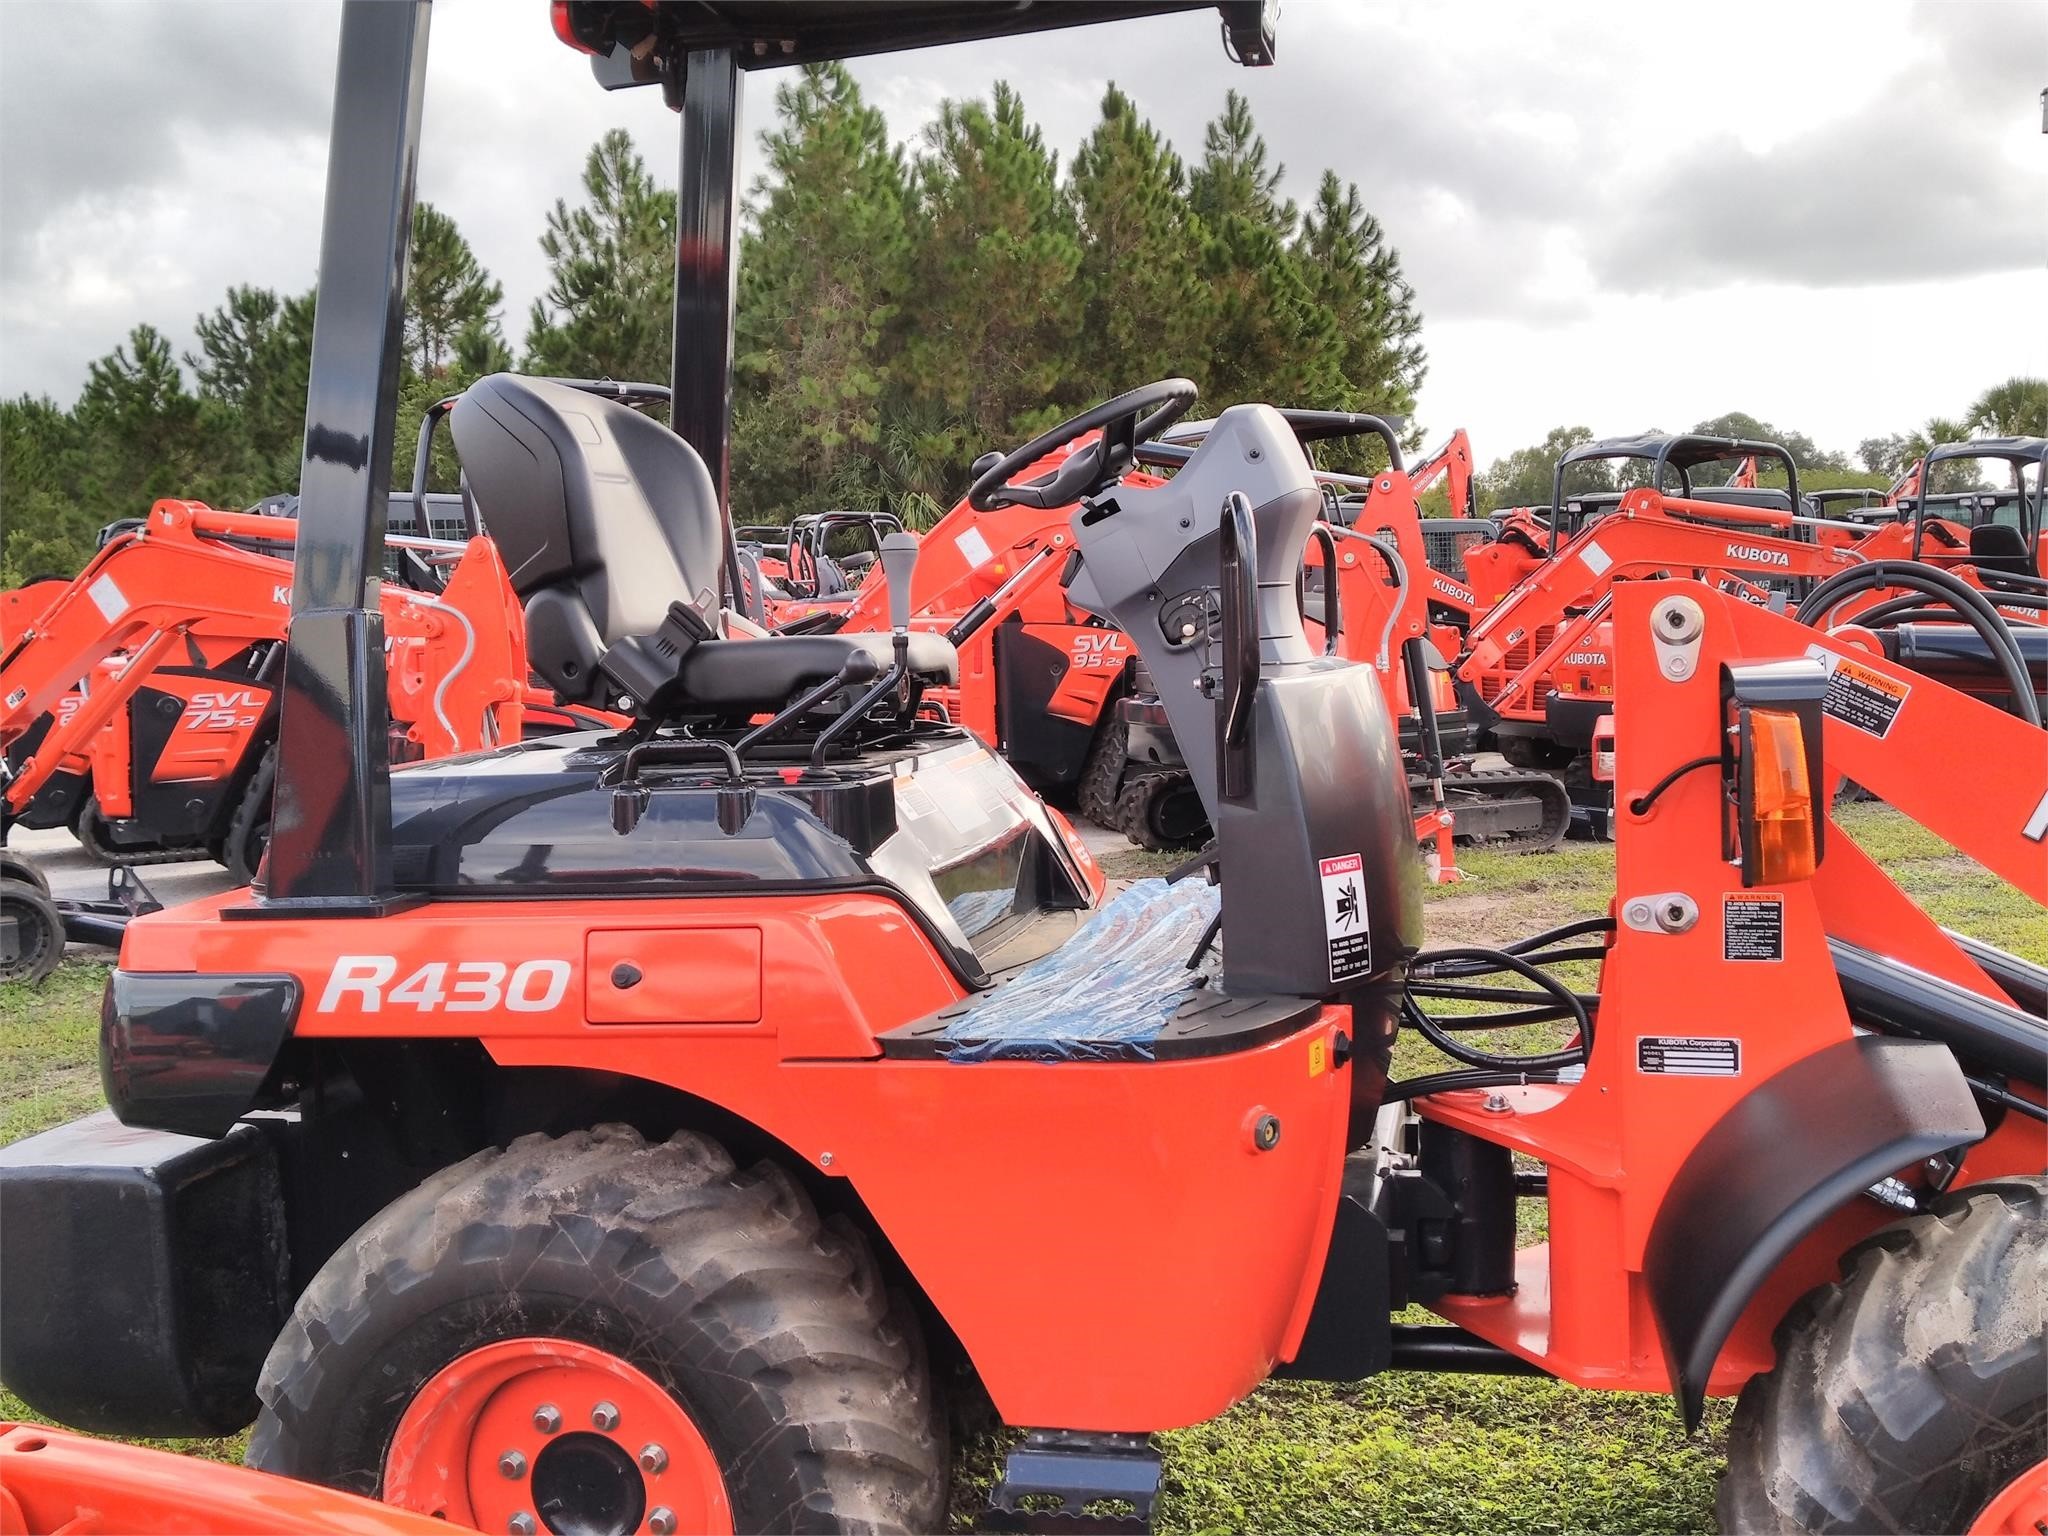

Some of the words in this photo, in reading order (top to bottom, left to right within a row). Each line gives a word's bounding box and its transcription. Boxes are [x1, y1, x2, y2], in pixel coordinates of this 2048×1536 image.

[1726, 544, 1789, 566] KUBOTA
[1432, 578, 1475, 605] KUBOTA
[1071, 633, 1127, 653] SVL
[1857, 671, 1898, 693] WARNING
[188, 692, 264, 709] SVL
[185, 710, 255, 729] 75-2
[1332, 859, 1358, 872] DANGER
[316, 955, 572, 1013] R430
